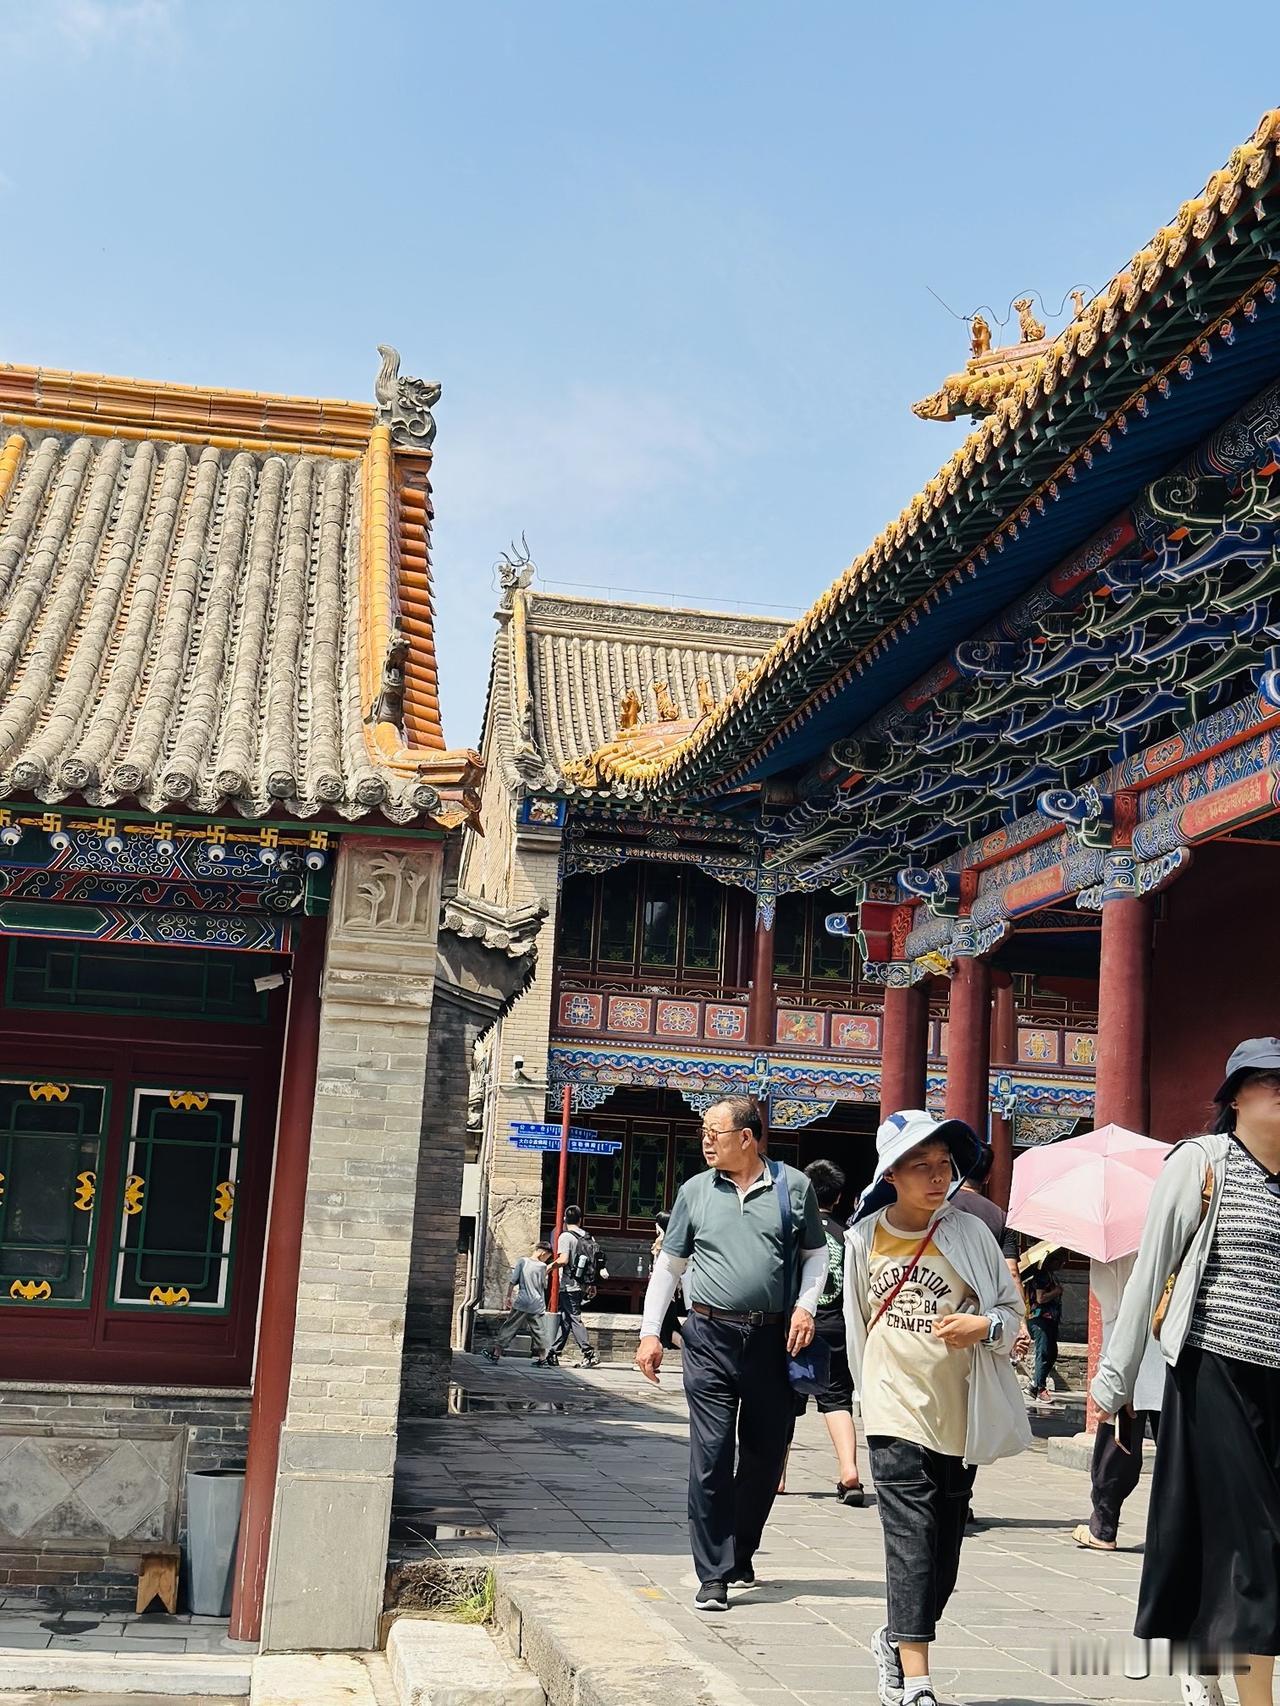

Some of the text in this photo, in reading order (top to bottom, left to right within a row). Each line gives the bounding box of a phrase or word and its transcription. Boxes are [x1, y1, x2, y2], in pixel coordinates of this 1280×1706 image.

[871, 1265, 952, 1299] RECREATION
[924, 1300, 937, 1314] 84
[886, 1313, 933, 1334] CHAMPS
